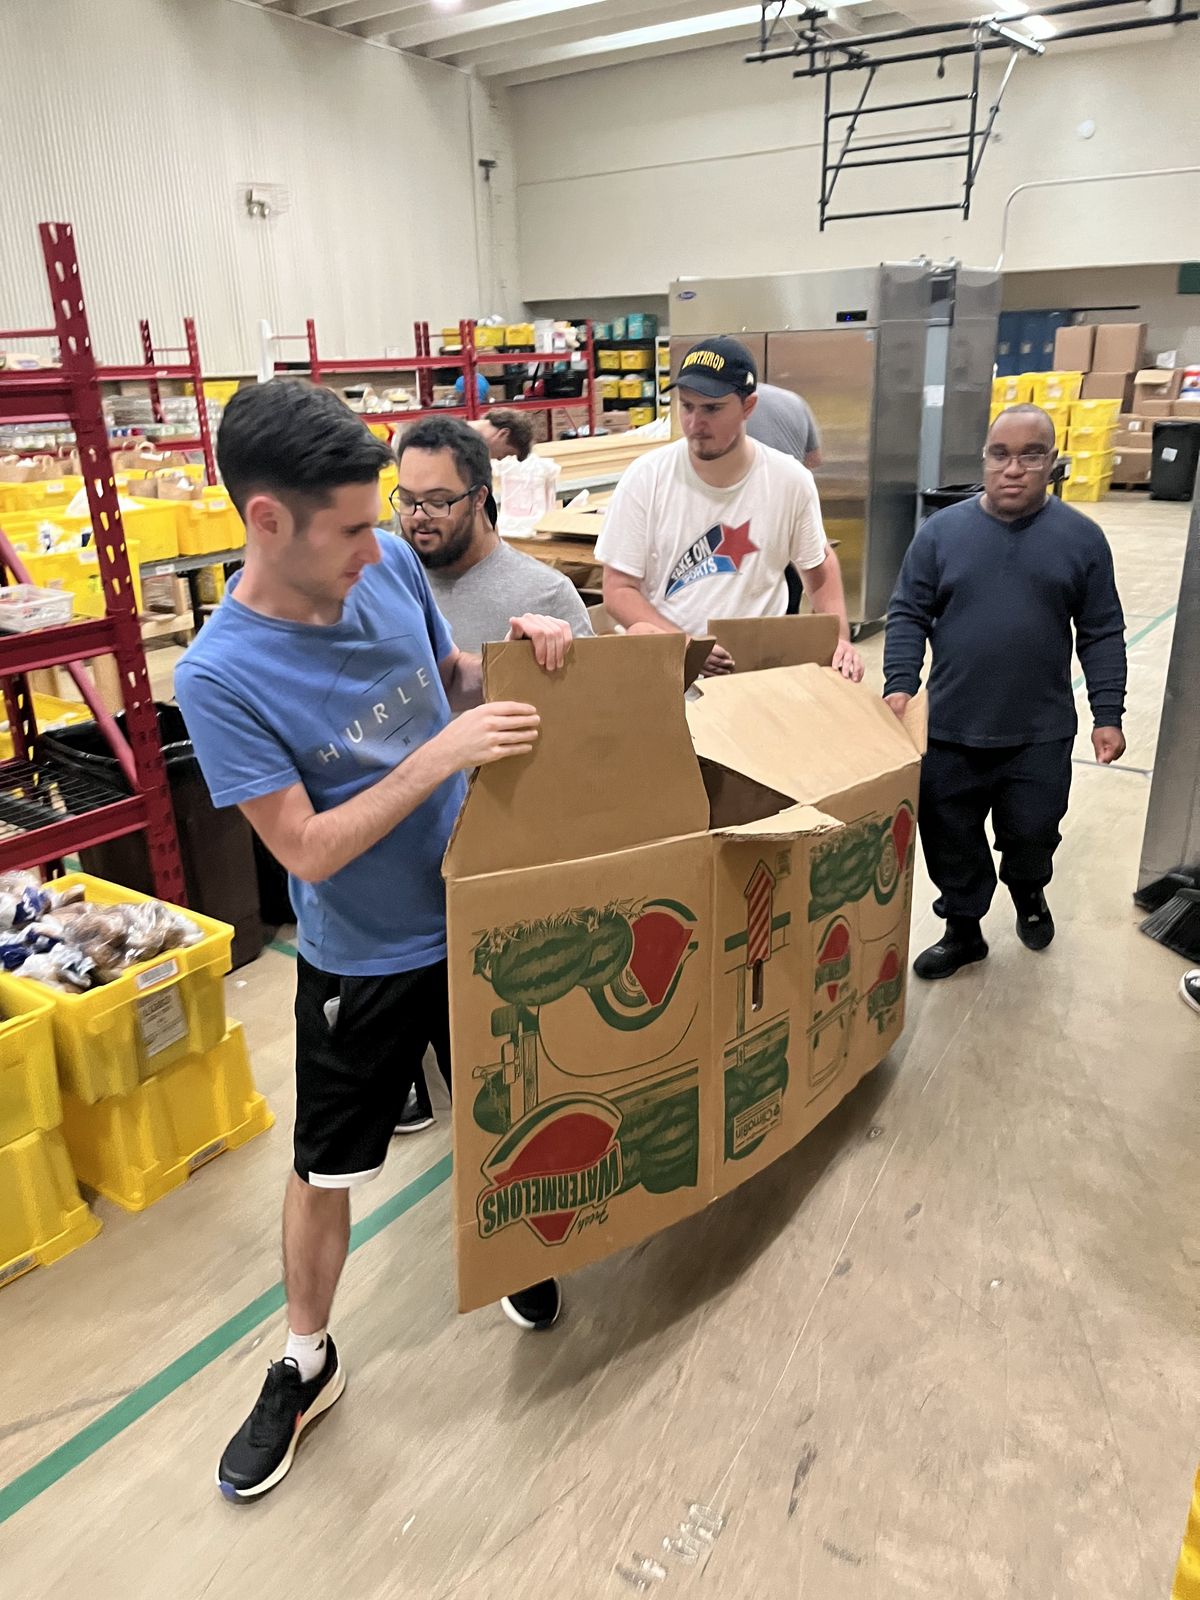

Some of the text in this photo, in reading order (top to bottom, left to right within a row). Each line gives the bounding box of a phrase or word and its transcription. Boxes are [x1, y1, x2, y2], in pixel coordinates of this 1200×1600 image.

[671, 535, 713, 580] TAKE ON
[682, 557, 718, 584] PORTS
[482, 1148, 619, 1234] WATERMELONS
